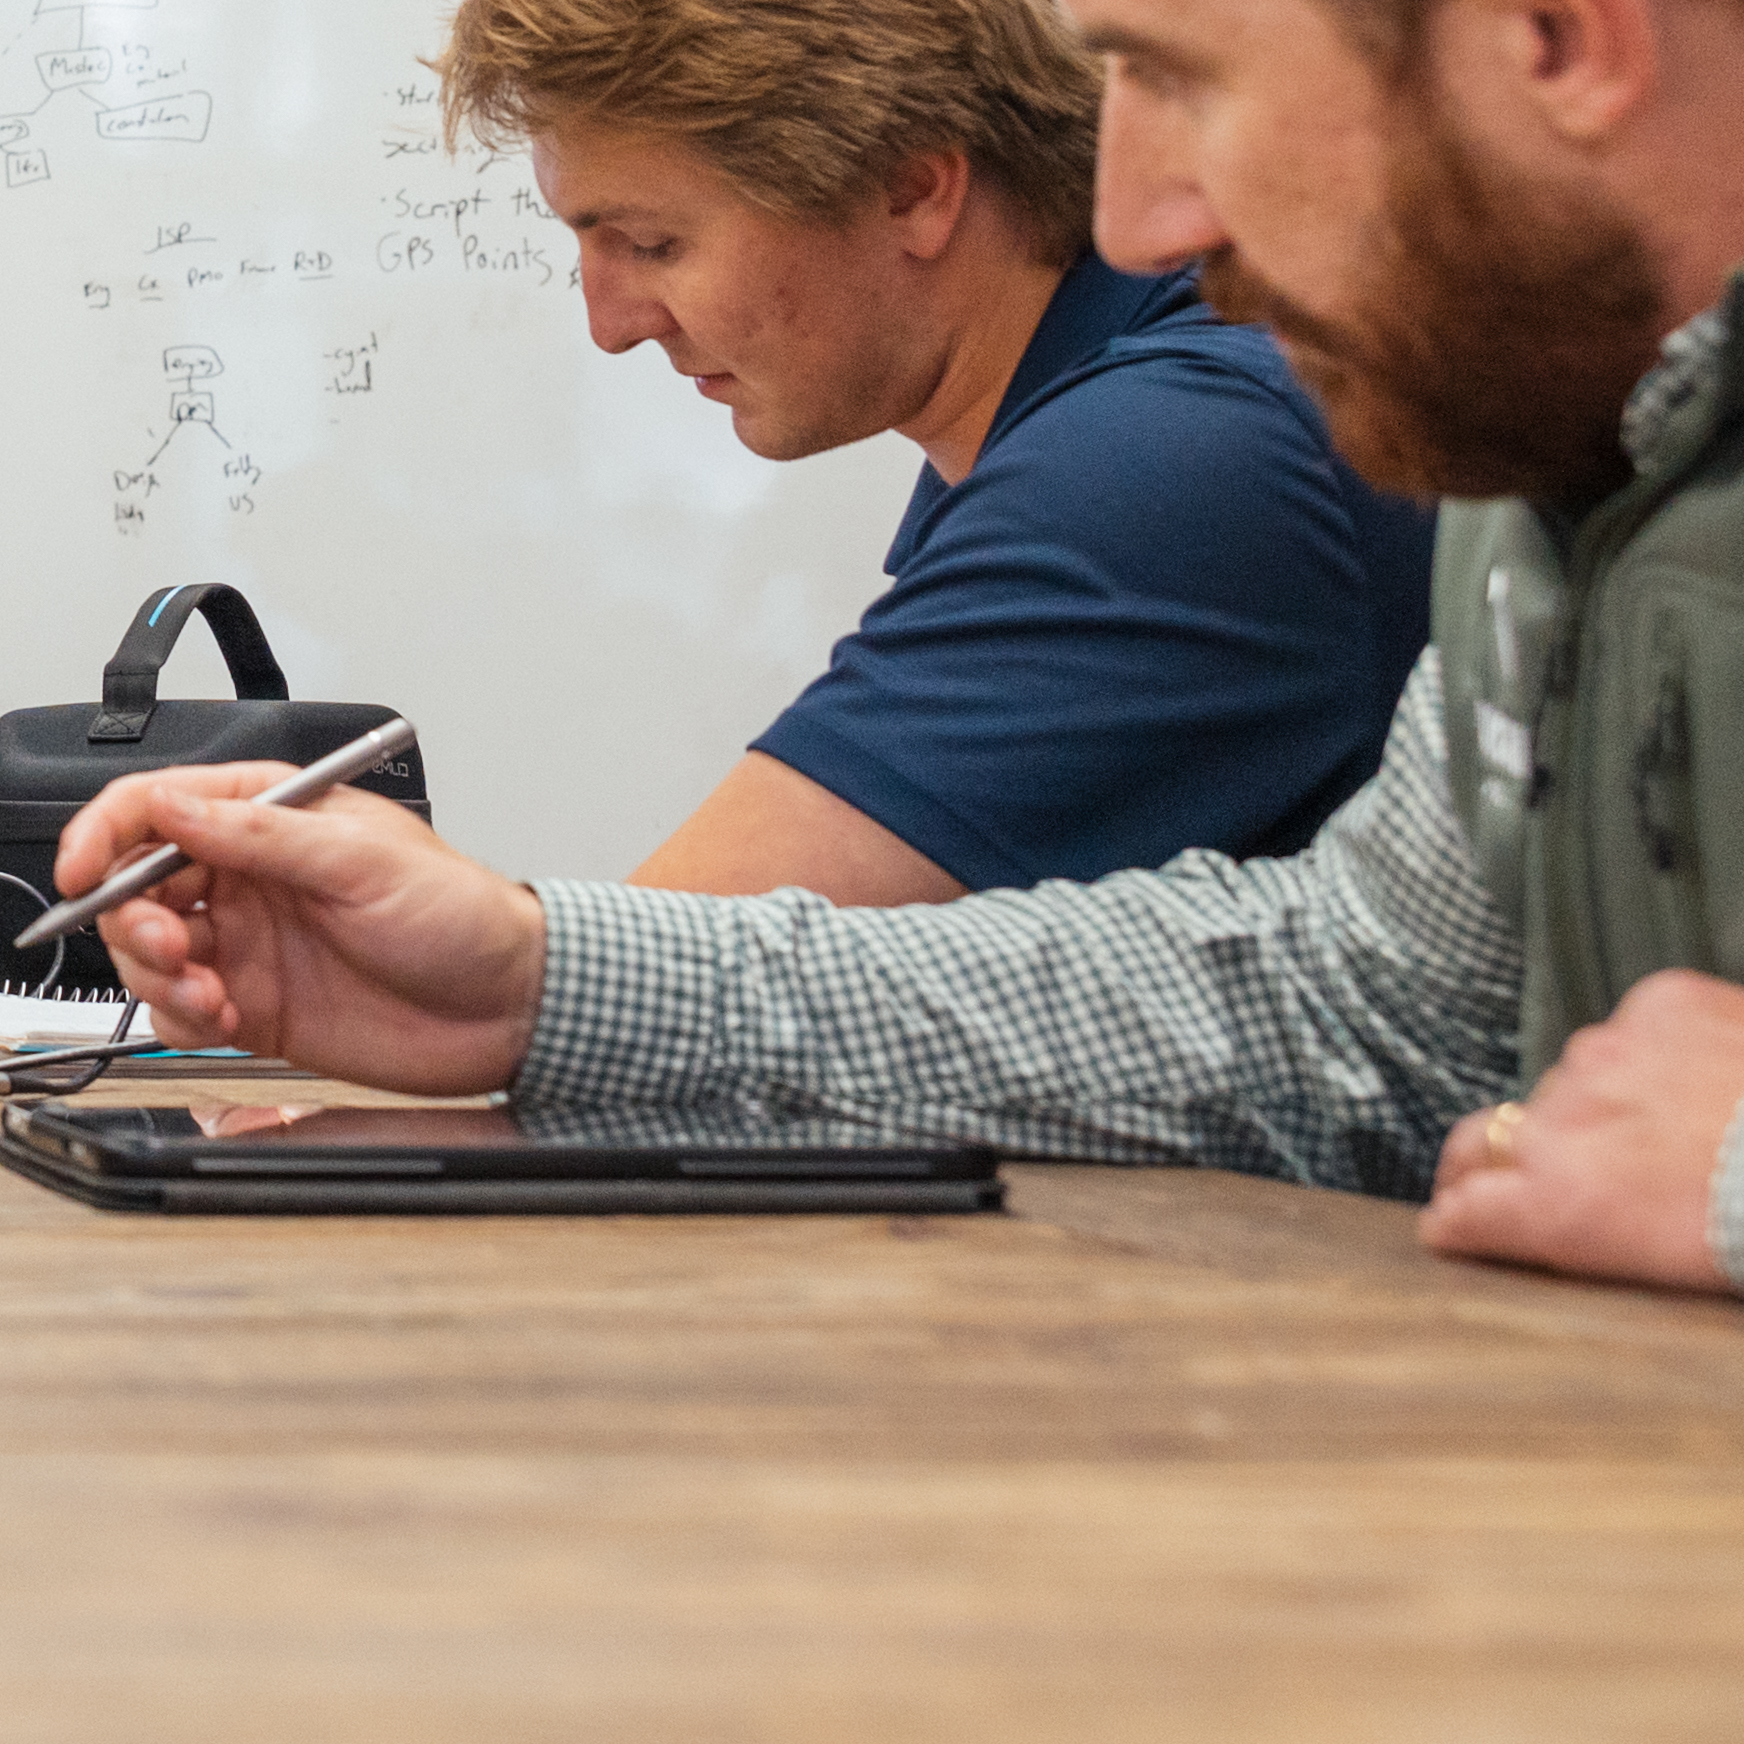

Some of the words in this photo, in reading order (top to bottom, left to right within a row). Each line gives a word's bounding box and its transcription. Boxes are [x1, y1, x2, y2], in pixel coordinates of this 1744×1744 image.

[395, 187, 492, 238] Script
[376, 230, 435, 273] GPS
[462, 233, 553, 287] Points
